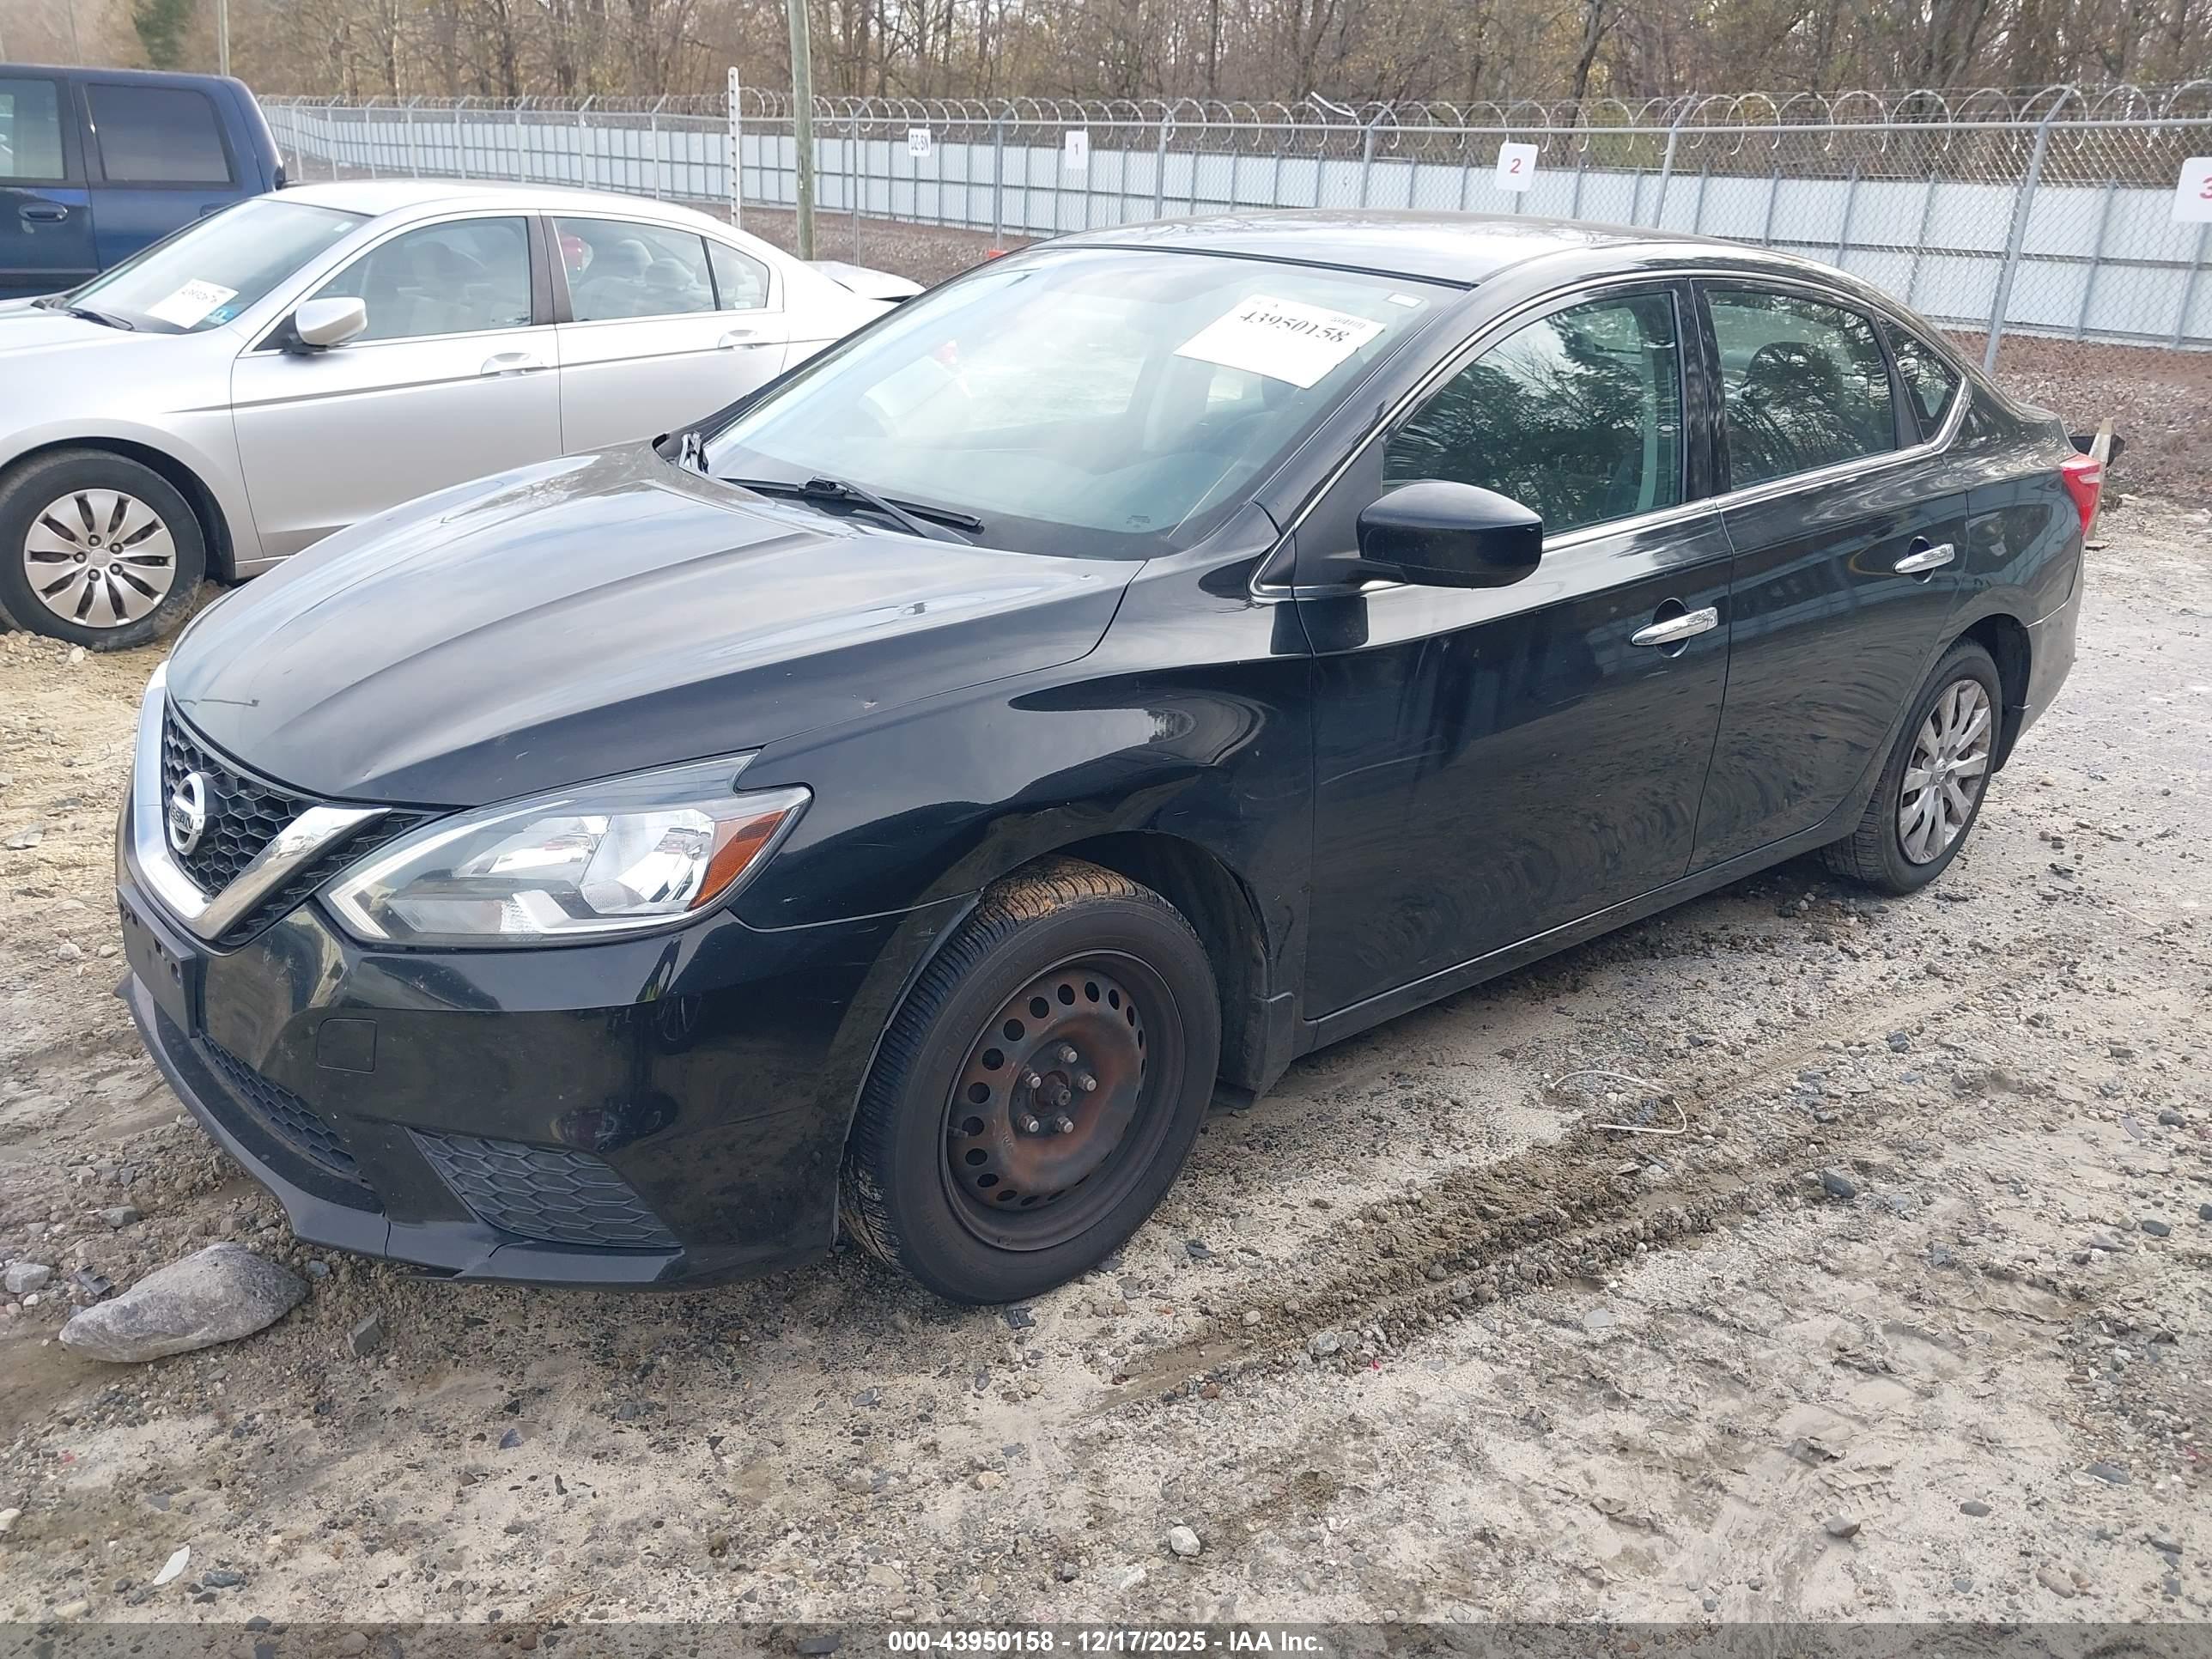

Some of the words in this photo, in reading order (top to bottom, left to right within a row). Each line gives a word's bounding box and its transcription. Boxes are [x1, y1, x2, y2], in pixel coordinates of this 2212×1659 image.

[1073, 143, 1079, 156] 1
[1510, 157, 1522, 174] 2
[2199, 176, 2212, 199] 3
[1237, 309, 1352, 344] 43950158
